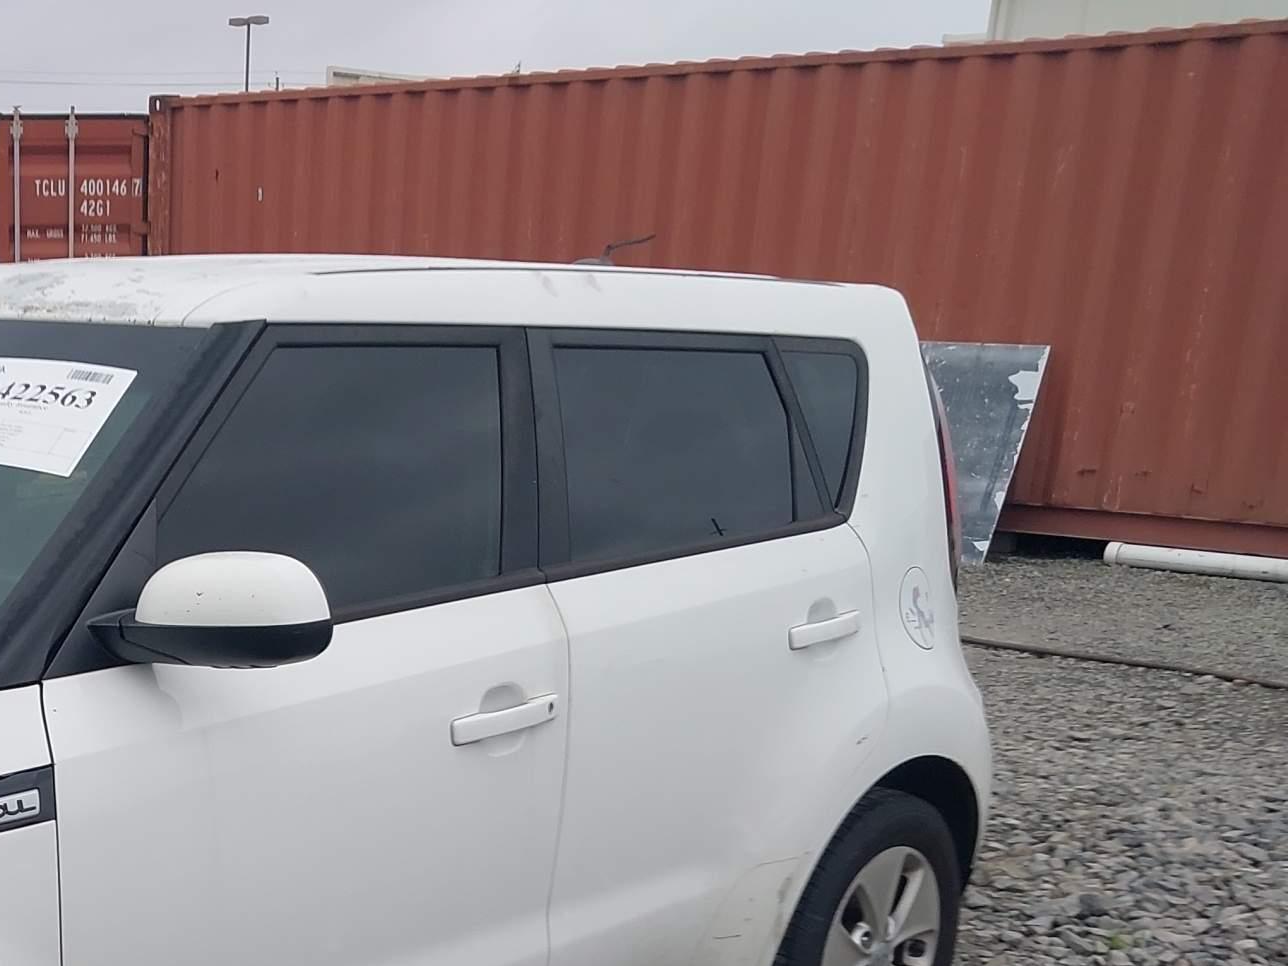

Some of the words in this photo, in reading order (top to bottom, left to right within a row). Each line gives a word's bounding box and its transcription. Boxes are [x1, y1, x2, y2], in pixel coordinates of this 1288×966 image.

[34, 179, 66, 197] TCLU
[80, 178, 127, 197] 400146
[80, 199, 110, 216] 42G1
